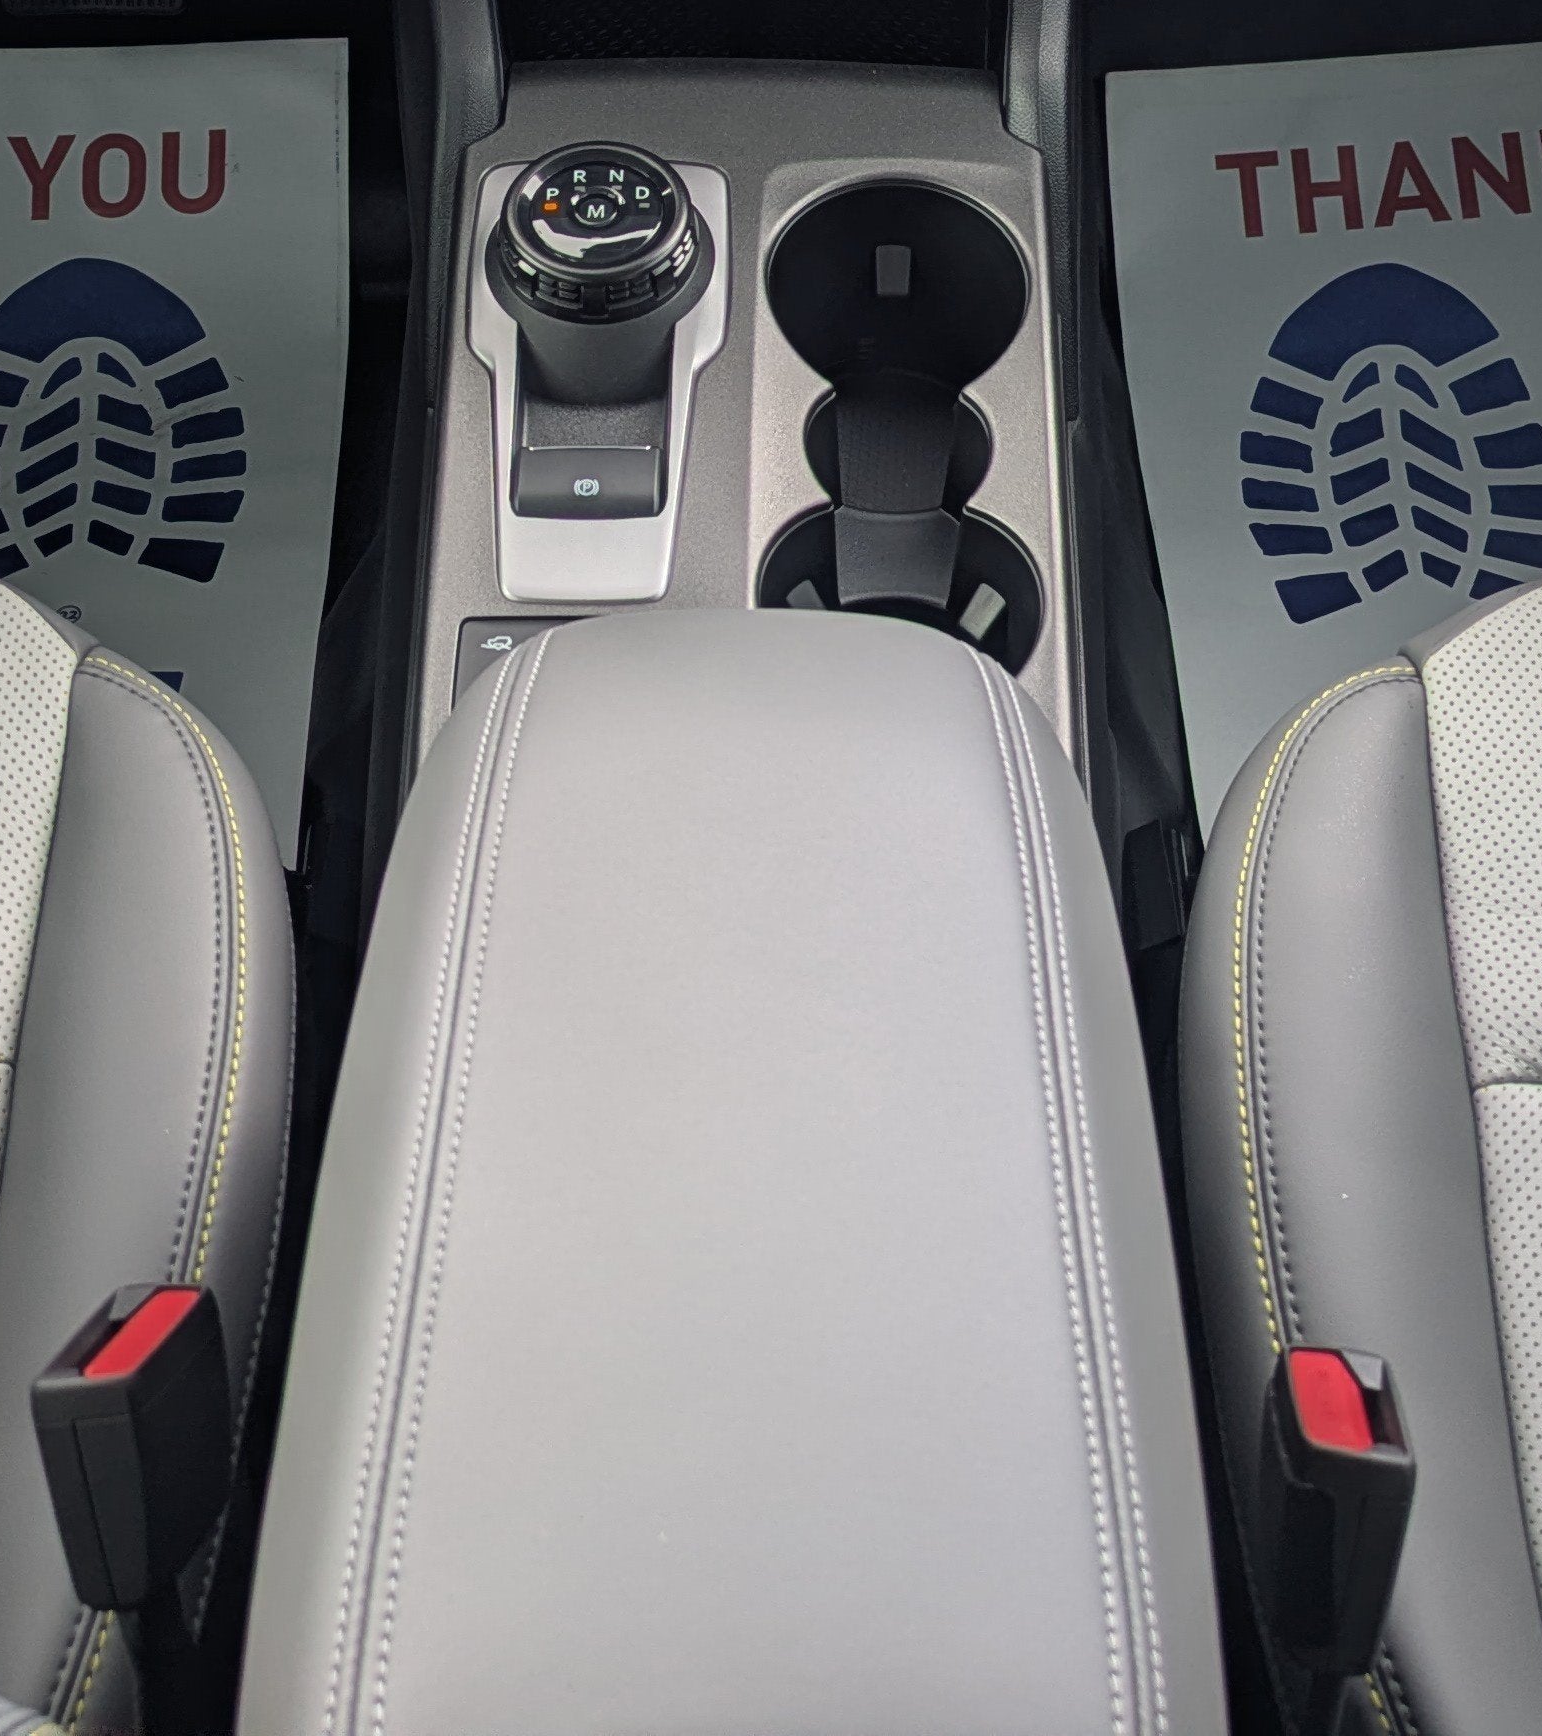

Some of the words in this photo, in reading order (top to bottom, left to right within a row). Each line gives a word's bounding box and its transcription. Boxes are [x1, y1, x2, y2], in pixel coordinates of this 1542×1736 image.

[8, 127, 228, 222] YOU
[573, 169, 587, 183] R
[609, 169, 625, 182] N
[546, 188, 560, 200] P
[635, 186, 650, 199] D
[587, 204, 605, 218] M
